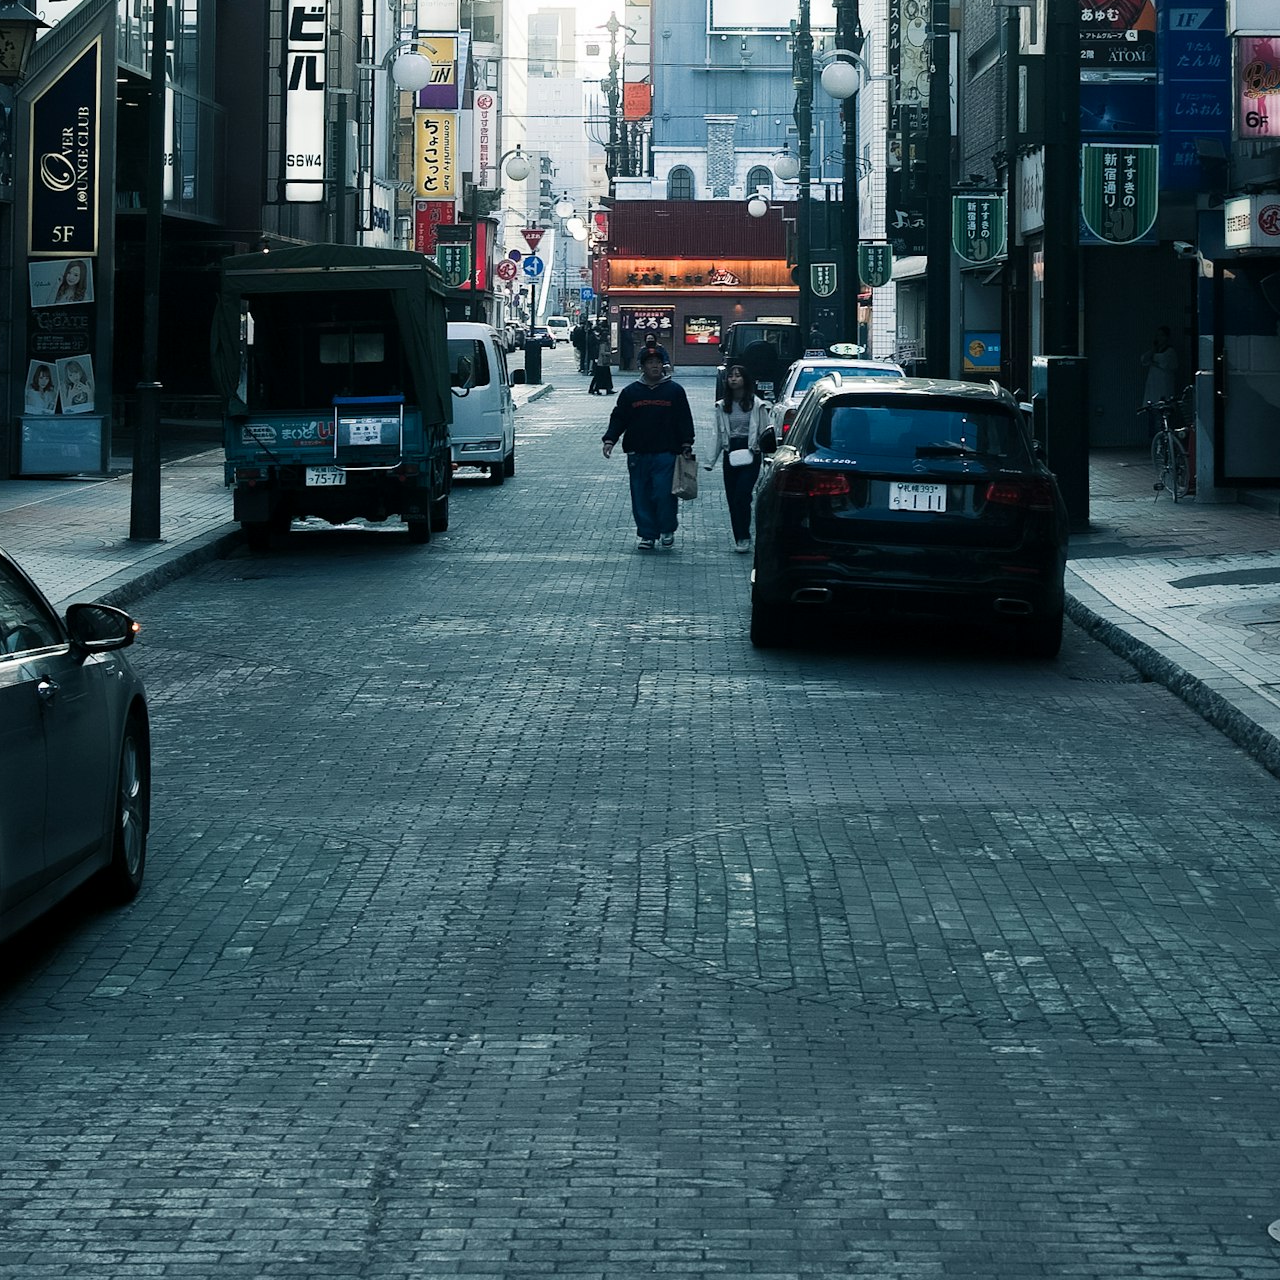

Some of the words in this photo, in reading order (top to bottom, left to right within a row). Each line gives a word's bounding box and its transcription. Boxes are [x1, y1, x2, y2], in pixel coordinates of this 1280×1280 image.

[1176, 12, 1199, 28] 1F
[1085, 31, 1124, 40] アトムグループ
[1080, 49, 1095, 60] 2階
[1108, 52, 1147, 63] ATOM
[76, 104, 91, 149] CLUB
[1245, 111, 1269, 128] 6F
[286, 153, 323, 169] S6W4
[424, 119, 440, 192] ちょこっと
[76, 150, 91, 212] LOUNGE
[1103, 152, 1118, 208] 新宿通り
[1122, 153, 1137, 208] すすきの
[966, 201, 977, 240] 新宿通り
[980, 201, 991, 240] すすきの
[51, 224, 75, 246] 5F
[633, 316, 673, 330] だるま
[313, 473, 345, 485] 75-77
[919, 484, 935, 494] 393
